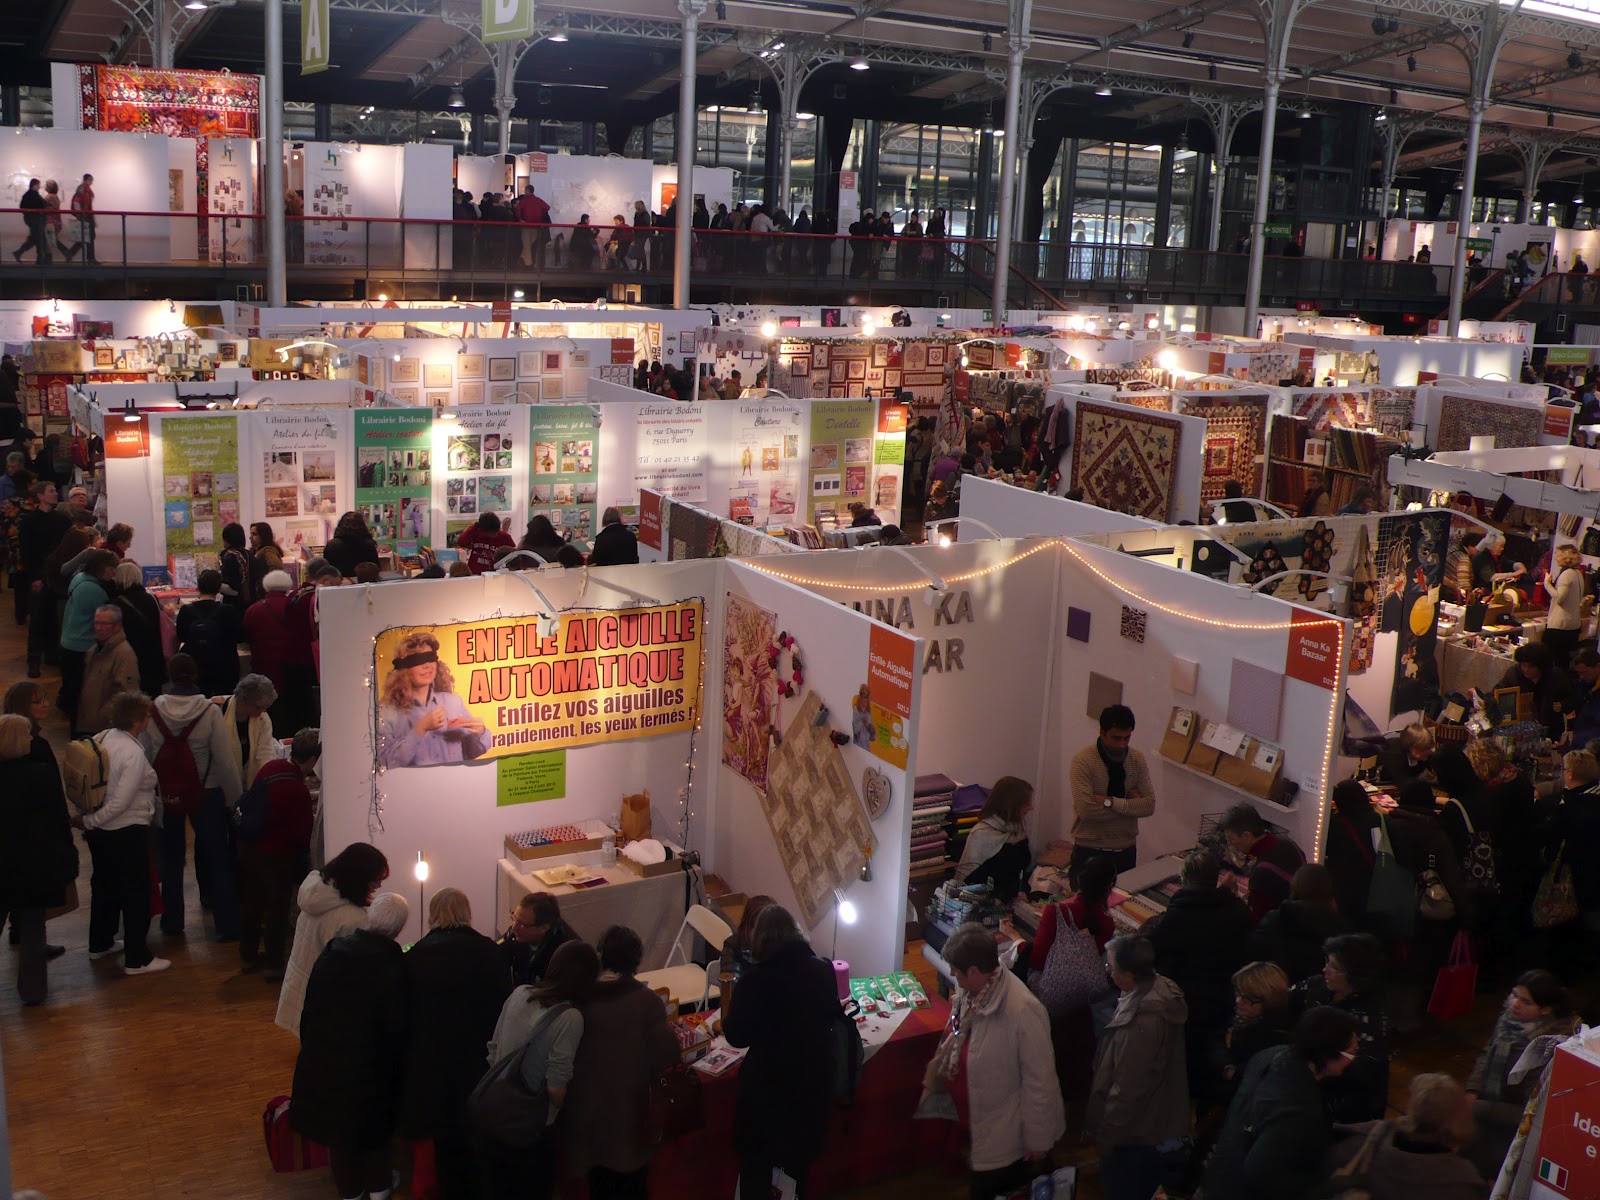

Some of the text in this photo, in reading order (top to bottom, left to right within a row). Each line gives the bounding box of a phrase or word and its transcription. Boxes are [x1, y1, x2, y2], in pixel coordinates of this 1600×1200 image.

[306, 0, 322, 61] A
[1272, 226, 1290, 234] SORTIE
[1475, 240, 1492, 248] SORTIE
[456, 409, 511, 418] ibrairie Bodoni
[537, 411, 592, 420] Librairie Bodon
[638, 404, 702, 416] Librairie Bodoni
[265, 415, 330, 424] Librairie Bodon
[361, 415, 426, 424] Librairie Bodoni
[457, 419, 508, 430] Atelier du fil
[754, 416, 781, 427] Couture
[825, 418, 862, 429] Dentelle
[168, 423, 232, 432] Librairie Bodoni
[273, 428, 325, 440] Atelier du fil
[364, 430, 393, 438] Atelier
[672, 436, 688, 444] Paris
[634, 472, 703, 480] www.librairiebodoni.com
[841, 591, 974, 629] NNA KA
[456, 608, 696, 665] ENFILE AIGUILLE
[1300, 636, 1331, 653] Anna Ka
[1302, 647, 1327, 662] Bazaar
[869, 652, 913, 679] Enfile Aiguilles
[468, 647, 686, 705] AUTOMATIQUE
[872, 665, 909, 690] Automatique
[497, 687, 684, 727] Enfilez vos aiguilles
[491, 706, 693, 748] rapidement, les yeux fermés !
[1573, 1112, 1600, 1138] Ide
